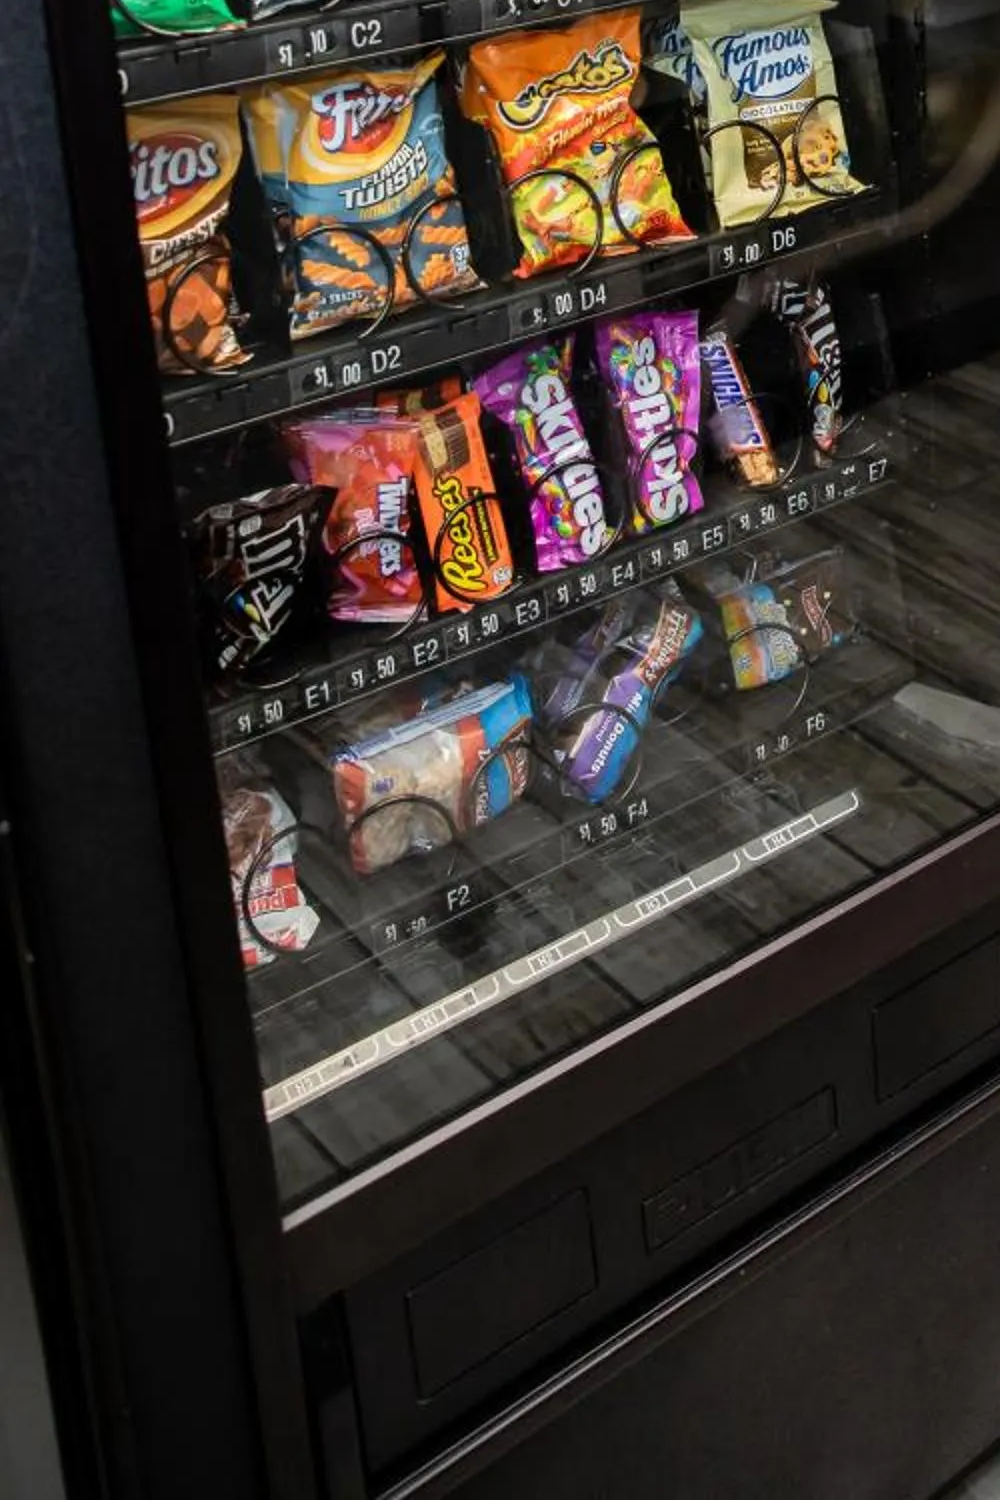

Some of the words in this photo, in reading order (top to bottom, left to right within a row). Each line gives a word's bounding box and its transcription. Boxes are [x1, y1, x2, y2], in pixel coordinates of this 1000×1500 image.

[351, 20, 382, 47] C2
[712, 26, 811, 81] Famous
[730, 53, 808, 103] Amos
[131, 140, 218, 200] itos
[338, 138, 429, 210] TWISTS
[361, 142, 414, 189] FLAVOR
[772, 227, 797, 252] D6
[580, 283, 607, 312] D4
[371, 345, 402, 375] D2
[628, 336, 691, 522] Skittles
[868, 458, 889, 483] E7
[786, 492, 810, 516] E6
[432, 473, 489, 593] Reese's
[701, 525, 724, 551] E5
[611, 560, 635, 587] E4
[515, 599, 541, 626] E3
[413, 638, 440, 667] E2
[304, 682, 331, 710] E1
[805, 712, 827, 737] F6
[590, 722, 627, 775] Donuts
[627, 799, 649, 825] F4
[446, 884, 470, 911] F2
